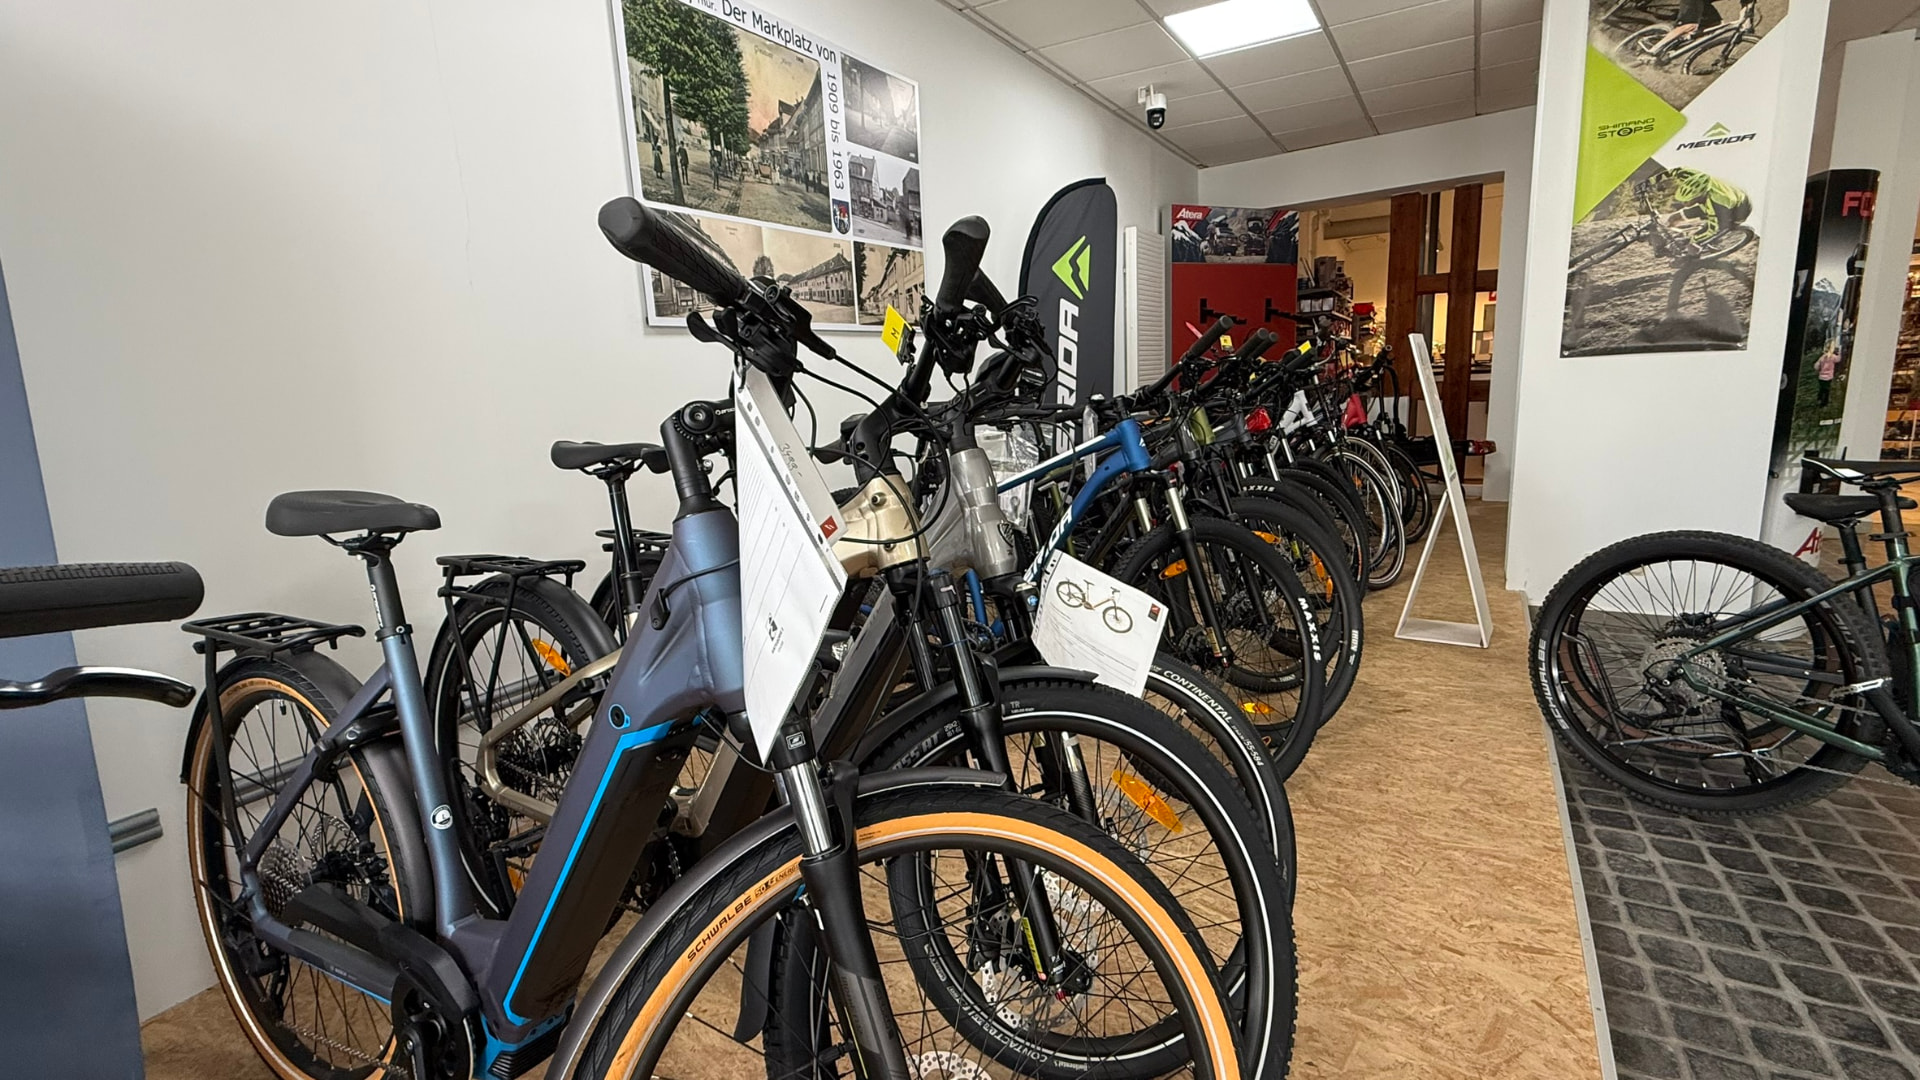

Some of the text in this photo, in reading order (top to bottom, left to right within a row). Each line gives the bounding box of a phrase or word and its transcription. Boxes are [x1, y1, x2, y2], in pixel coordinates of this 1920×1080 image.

[722, 0, 747, 24] Der
[752, 11, 813, 54] Markplatz
[816, 43, 838, 65] von
[827, 71, 839, 114] 1909
[830, 119, 841, 144] bis
[1598, 117, 1656, 131] SHIMANO
[1676, 133, 1757, 151] MERIDA
[832, 150, 845, 190] 1963
[1176, 207, 1203, 220] Atera
[1055, 298, 1079, 455] ERIDA
[1298, 597, 1322, 661] MAXXIS
[1163, 670, 1234, 724] CONTINENTAL
[1538, 638, 1569, 730] SCHWALBE
[687, 895, 753, 962] SCHWALBE
